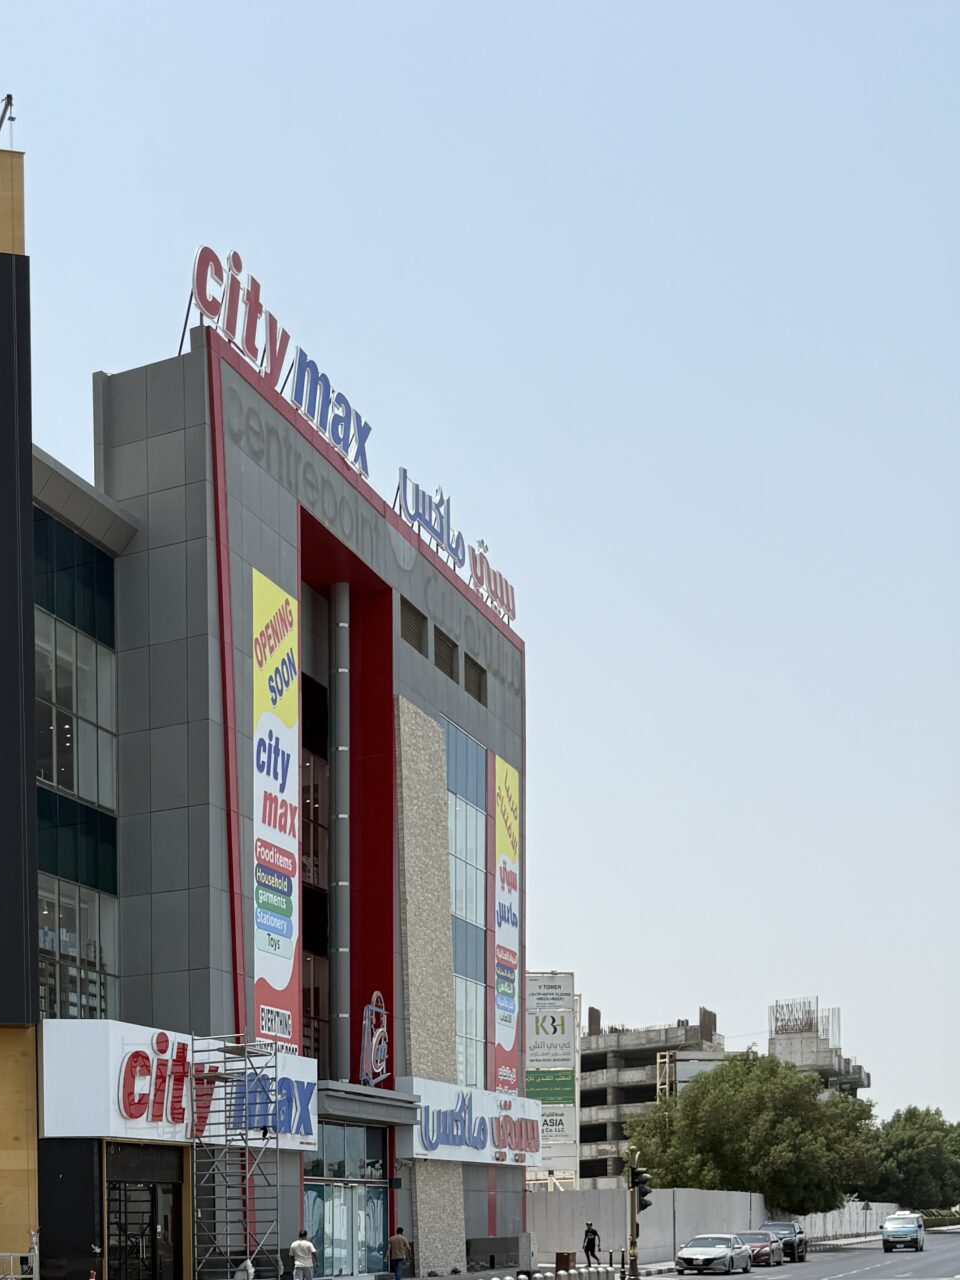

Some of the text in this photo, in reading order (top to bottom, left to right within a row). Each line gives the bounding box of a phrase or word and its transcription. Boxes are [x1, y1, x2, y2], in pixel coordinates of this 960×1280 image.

[192, 245, 372, 479] city max
[399, 467, 465, 568] ماكس
[253, 598, 294, 668] OPENING
[268, 648, 297, 706] SOON
[256, 729, 290, 793] city
[261, 790, 297, 838] max
[256, 841, 293, 871] Food items
[256, 867, 288, 892] Household
[256, 907, 287, 934] Stationery
[259, 889, 286, 909] garments
[267, 932, 281, 951] Toys
[261, 1007, 291, 1037] EVERYTHING
[121, 1031, 317, 1139] city max
[421, 1090, 540, 1163] سيتي ماكس
[542, 1118, 565, 1127] ASIA
